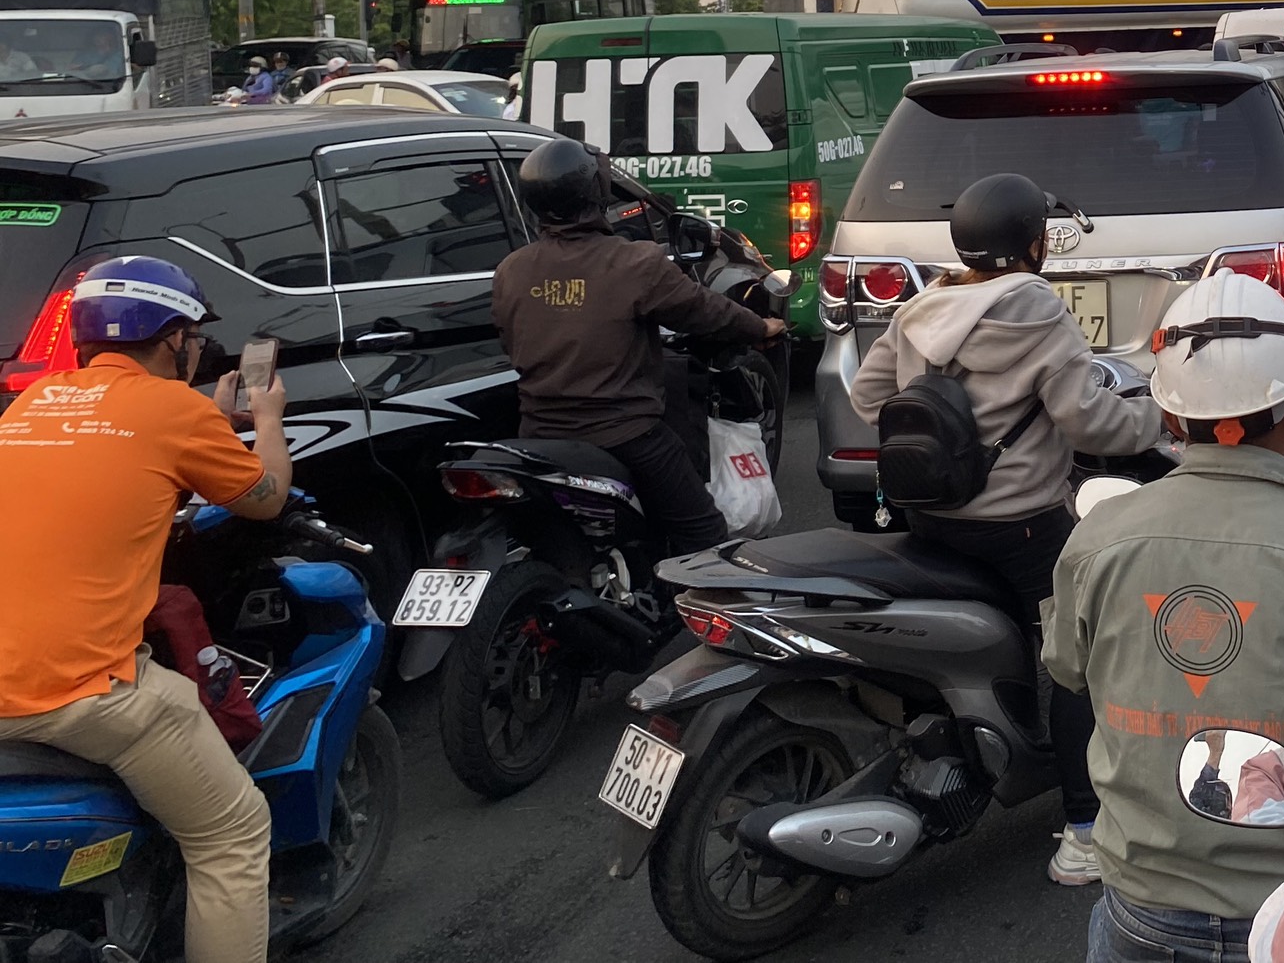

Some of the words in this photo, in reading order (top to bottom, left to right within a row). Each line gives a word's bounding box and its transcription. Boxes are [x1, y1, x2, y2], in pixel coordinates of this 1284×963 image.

[611, 155, 713, 179] 0G-027.46
[419, 575, 476, 597] 93-P2
[400, 599, 472, 622] 859.12
[625, 735, 673, 785] 50-Y1
[606, 767, 662, 821] 700.03
